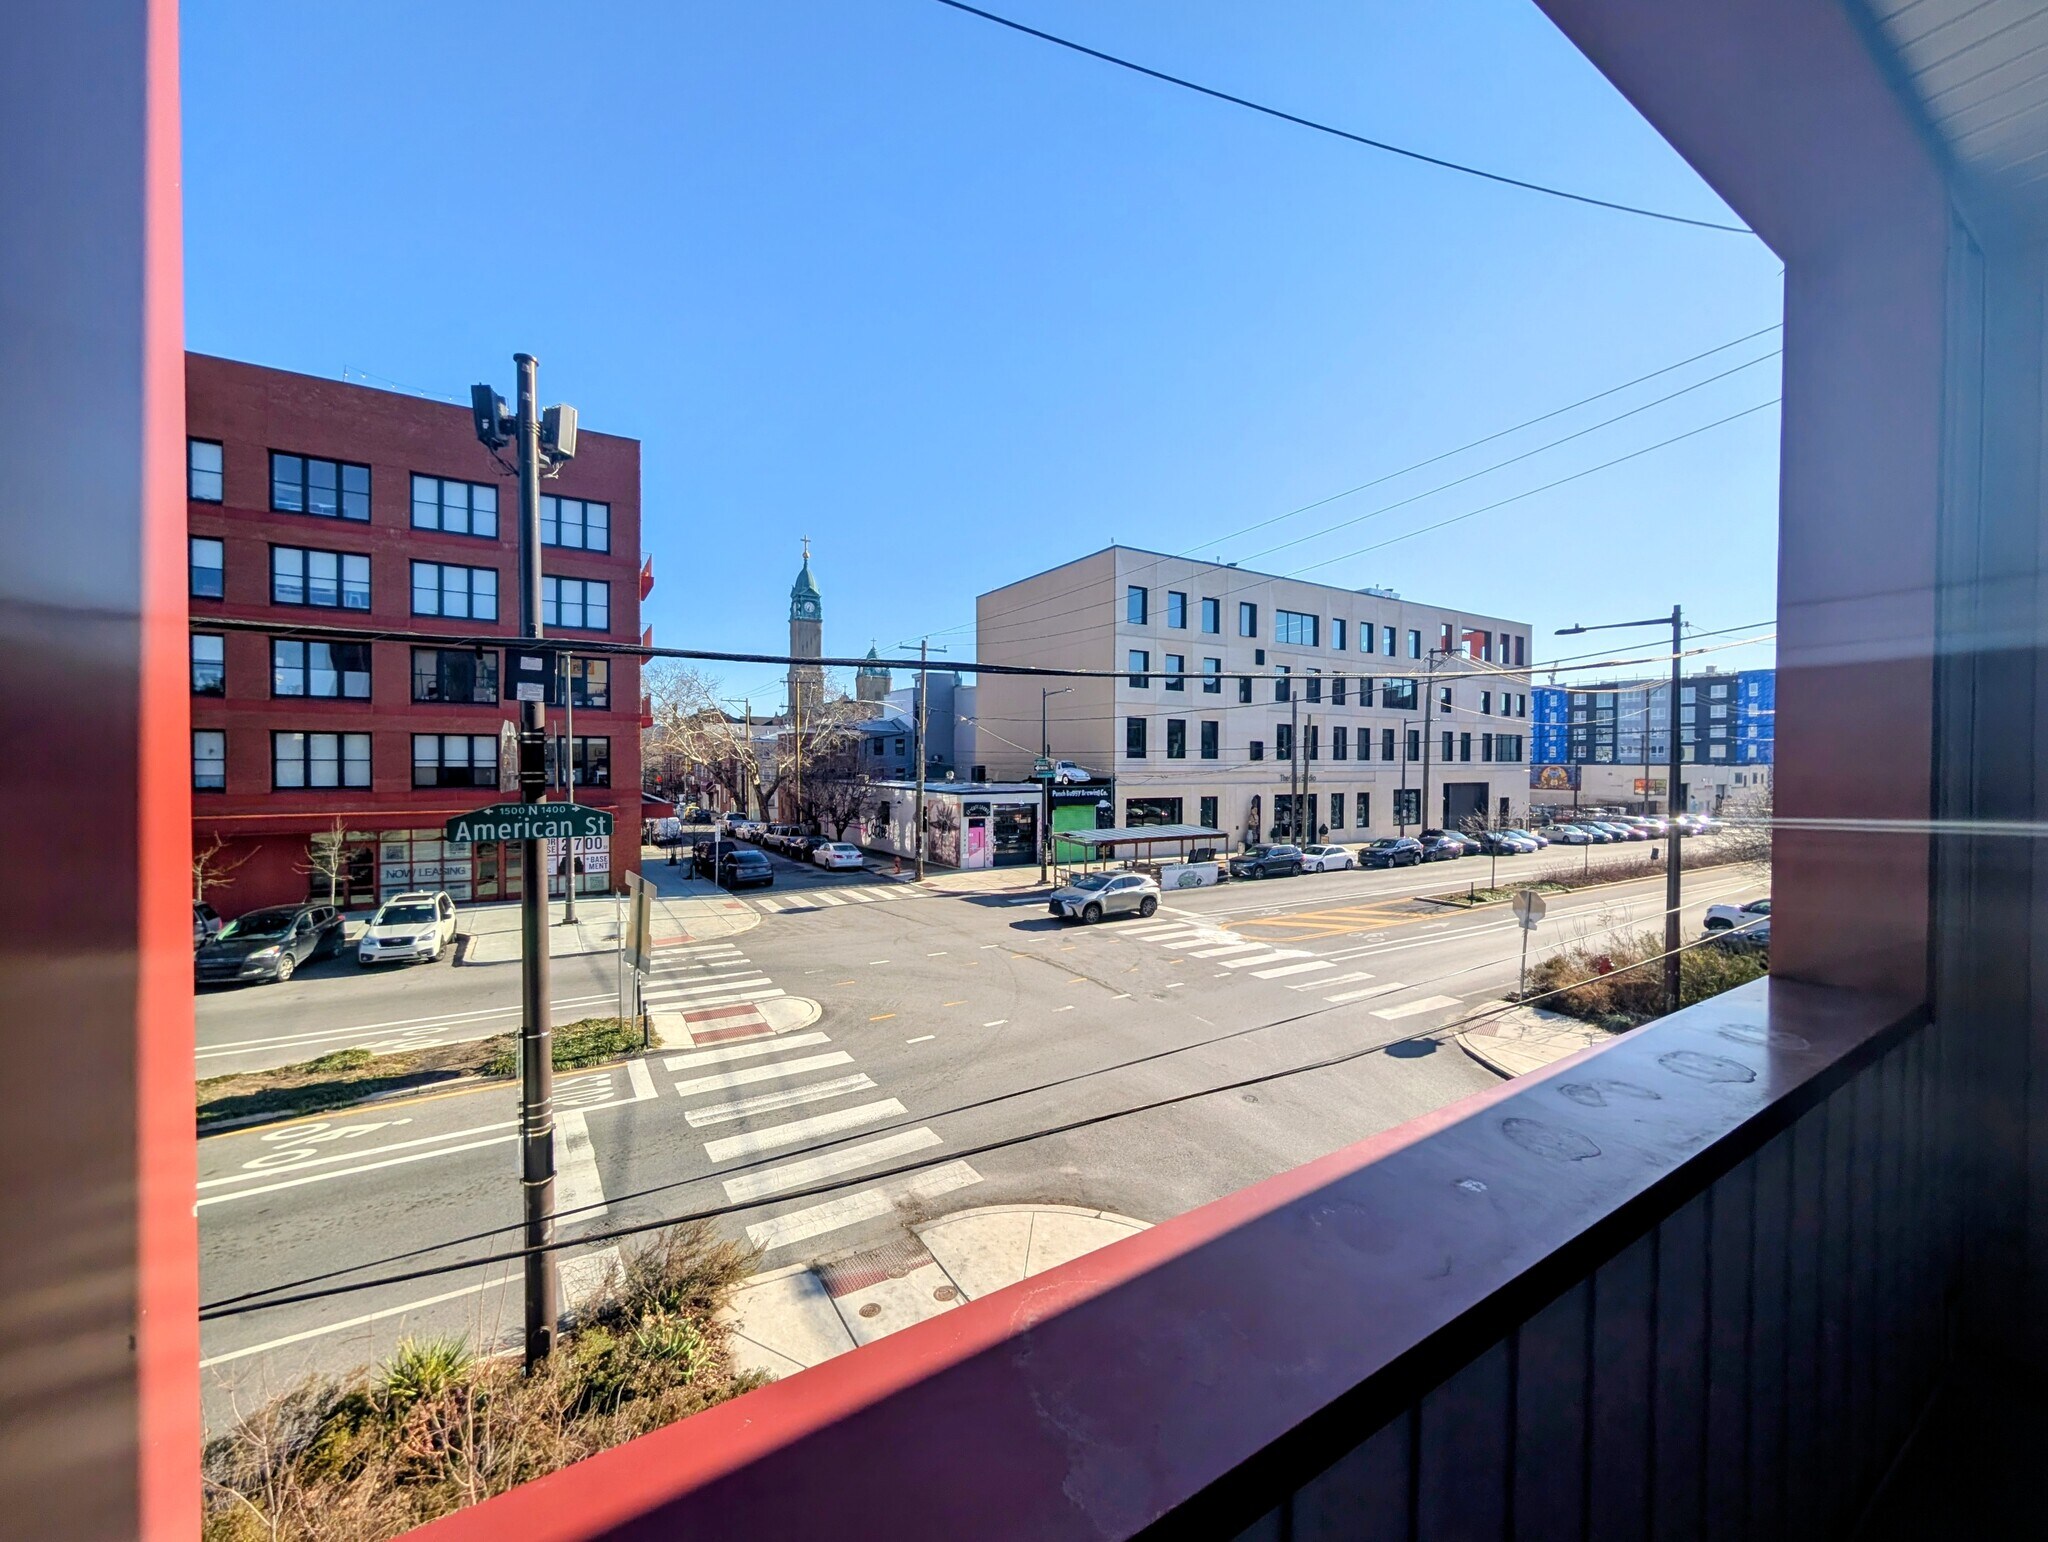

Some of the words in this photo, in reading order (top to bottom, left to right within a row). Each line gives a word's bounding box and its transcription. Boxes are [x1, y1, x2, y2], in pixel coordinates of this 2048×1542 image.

[500, 807, 525, 815] 1500
[528, 805, 538, 815] N
[541, 805, 566, 814] 1400
[455, 817, 573, 842] American
[585, 816, 606, 836] St
[386, 868, 416, 879] NOW
[419, 866, 466, 877] LEASING
